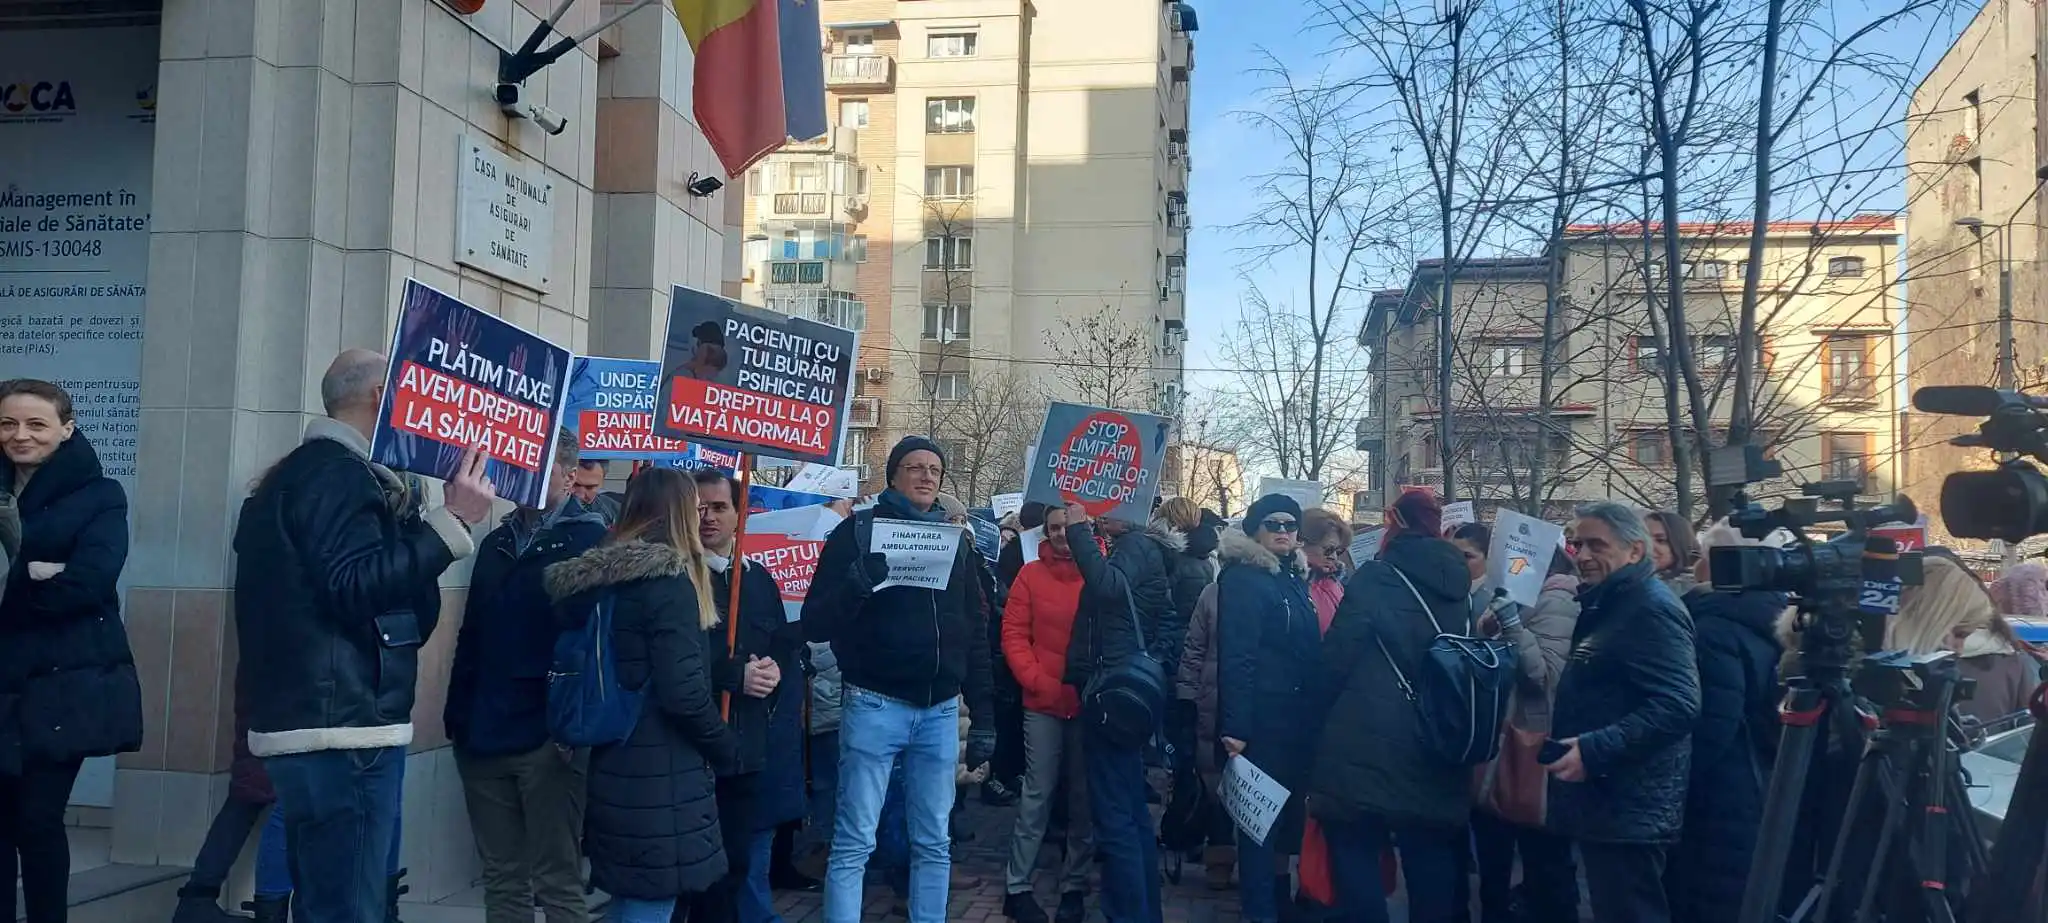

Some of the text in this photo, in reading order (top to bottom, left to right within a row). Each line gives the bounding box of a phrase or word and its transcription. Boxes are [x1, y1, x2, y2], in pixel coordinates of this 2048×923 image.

[0, 81, 76, 112] OCA
[475, 157, 497, 181] CASA
[1, 189, 136, 211] Management în
[506, 194, 517, 207] DE
[0, 215, 31, 232] iale
[38, 215, 59, 232] de
[505, 228, 515, 242] DE
[490, 241, 528, 269] SĂNĂTATE
[18, 287, 32, 297] DE
[34, 285, 87, 297] ASIGURĂRI
[90, 286, 104, 297] DE
[106, 284, 146, 297] SĂNĂTA
[0, 315, 22, 328] gică
[28, 315, 64, 326] bazată
[70, 317, 83, 328] pe
[89, 315, 124, 326] dovezi
[18, 330, 56, 340] datelor
[59, 330, 105, 341] specifice
[725, 318, 840, 362] PACIENȚII CU
[1, 343, 58, 355] tate (PIAS).
[428, 337, 503, 388] PLĂTIM
[742, 346, 837, 385] TULBURĂRI
[85, 379, 119, 391] pentru
[121, 381, 139, 391] sup
[600, 372, 658, 389] UNDE A
[737, 369, 833, 406] PSIHICE AU
[95, 393, 106, 403] de
[109, 395, 115, 403] a
[400, 365, 546, 438] AVEM DREPTUL
[595, 391, 655, 409] DISPĂR
[705, 386, 830, 428] DREPTUL LA O
[102, 422, 138, 434] Națion
[597, 412, 652, 429] BANII D
[670, 404, 826, 450] VIAȚĂ NORMALĂ.
[1088, 420, 1128, 441] STOP
[112, 438, 136, 447] care
[405, 401, 542, 468] LA SĂNĂTATE!
[585, 430, 681, 450] SĂNĂTATE?
[99, 451, 136, 464] instituț
[701, 448, 735, 468] DREPTUL
[1069, 437, 1137, 462] LIMITĂRII
[105, 466, 136, 476] ionale
[1048, 453, 1149, 485] DREPTURILOR
[1049, 473, 1136, 503] MEDICILOR!
[881, 543, 950, 552] AMBULATORIULUI
[771, 563, 818, 581] ĂNĂTA
[1859, 590, 1900, 613] 24
